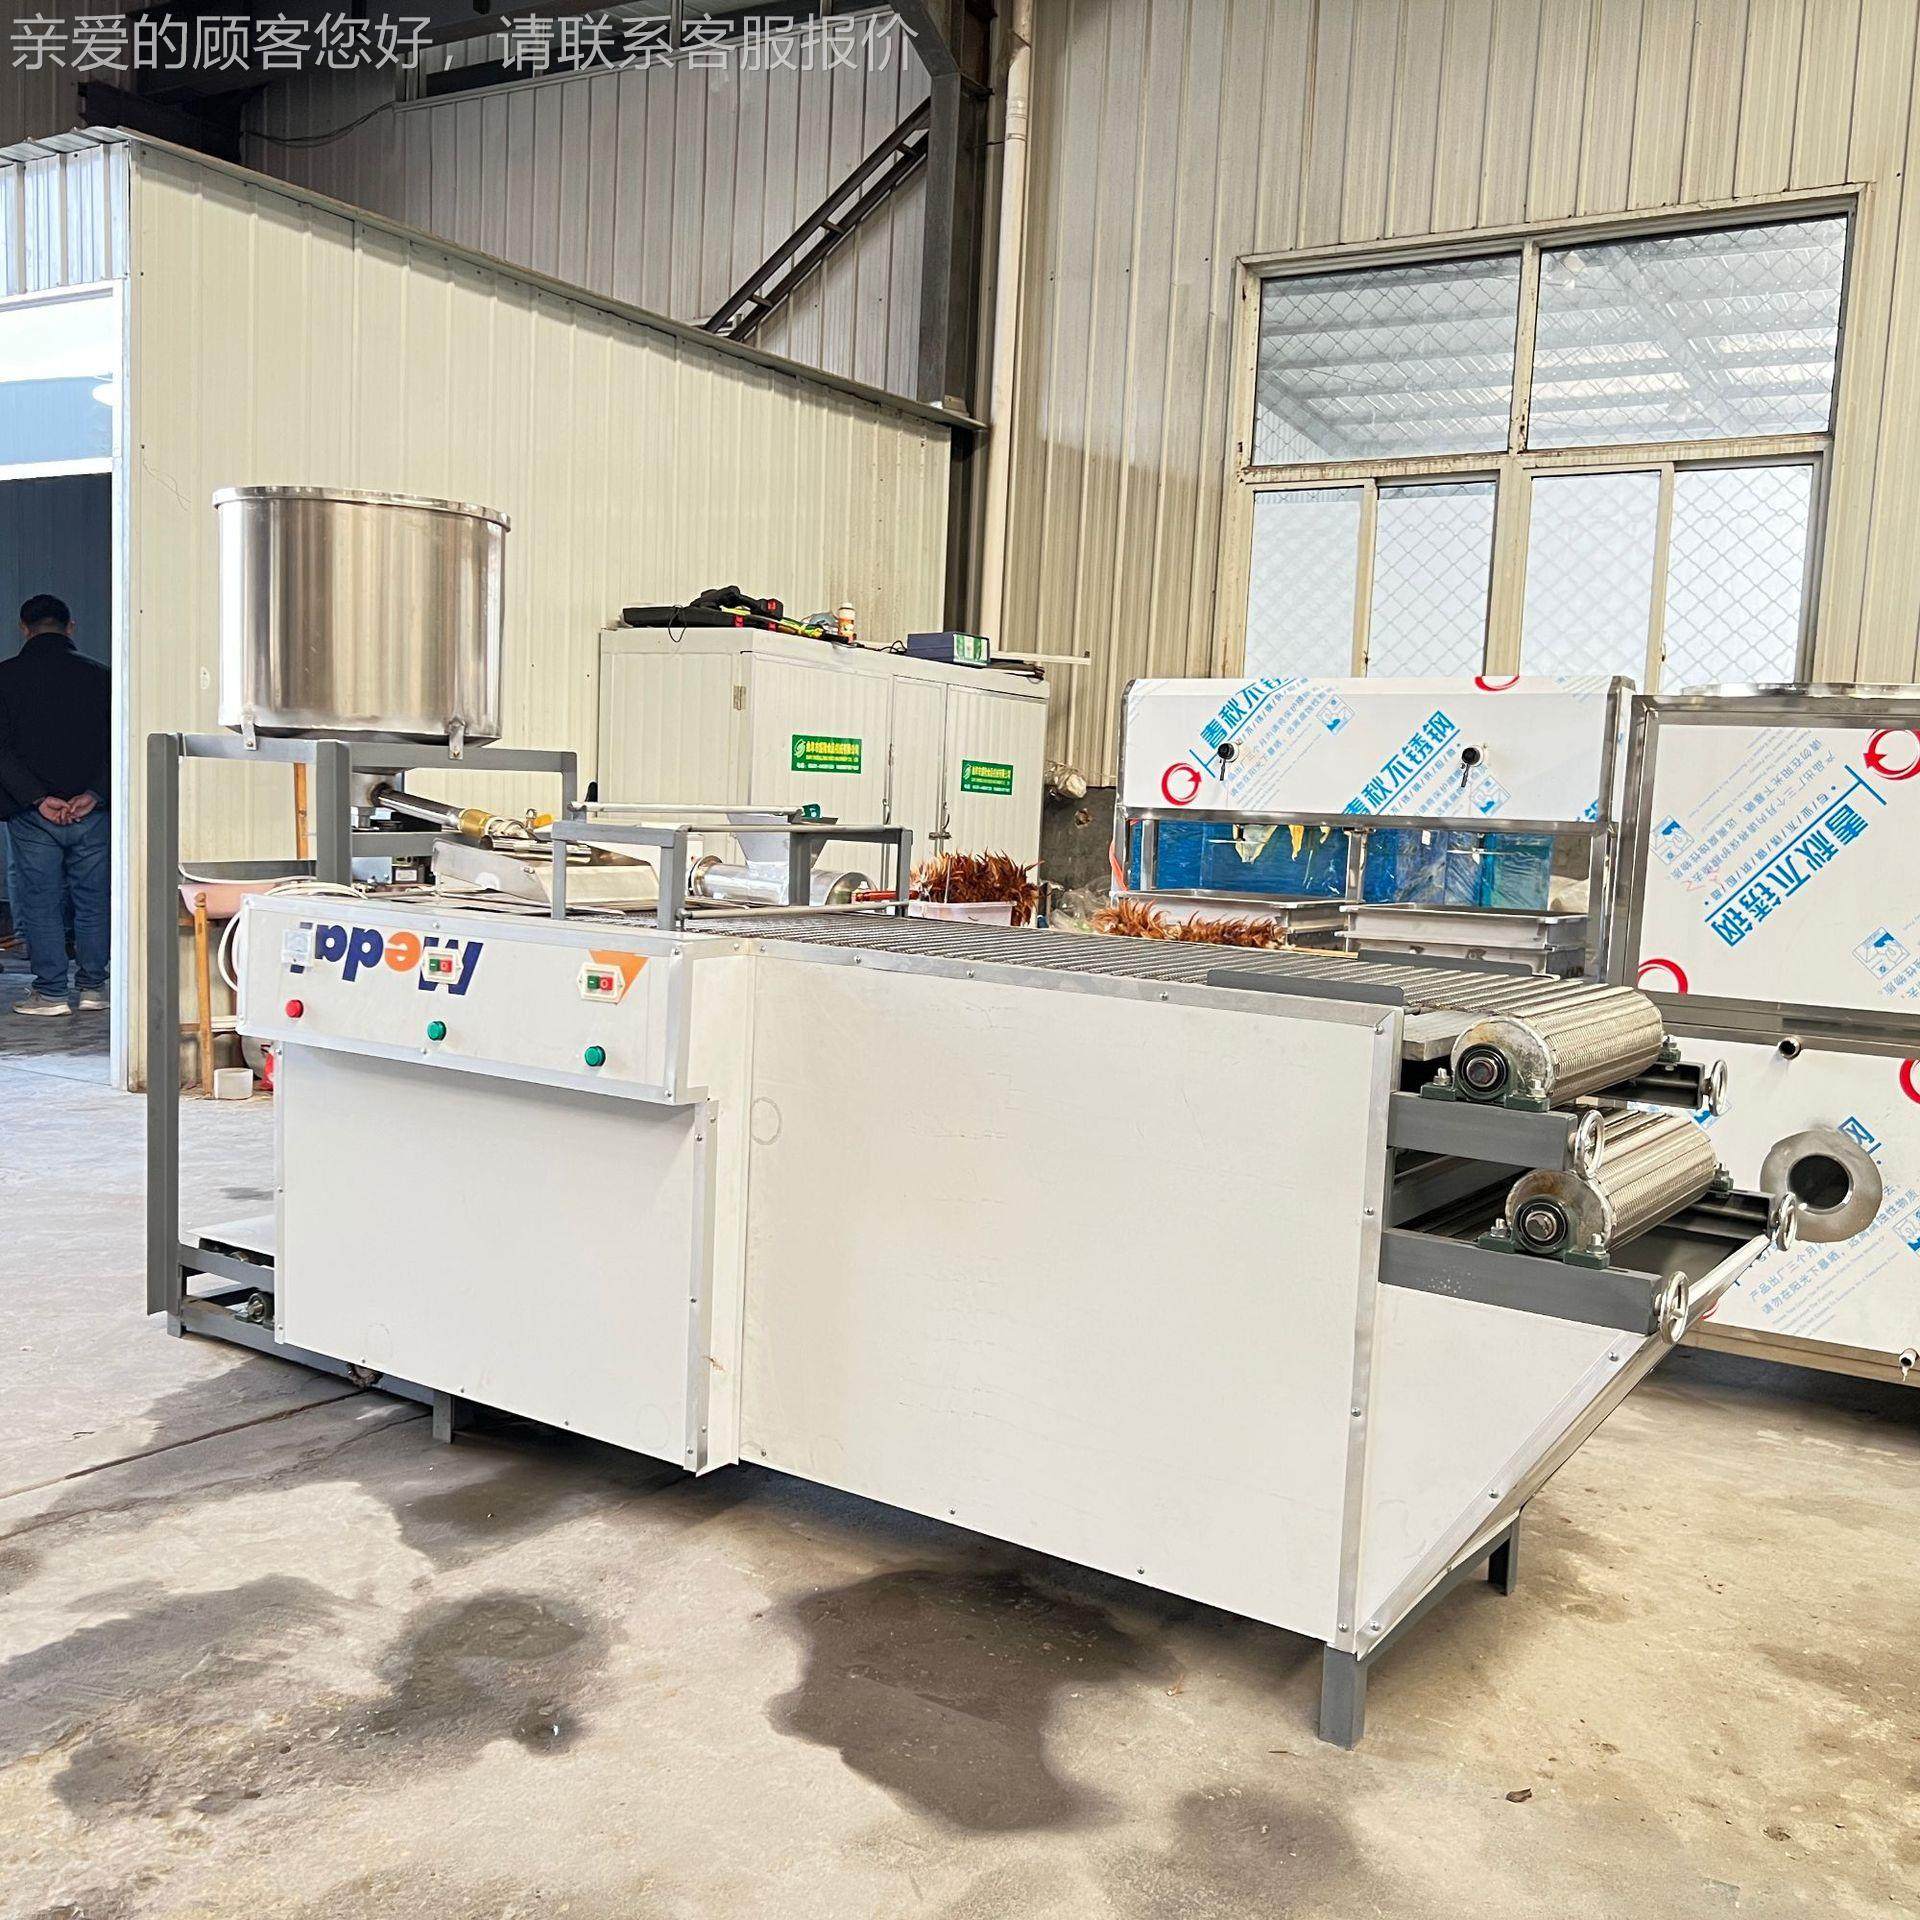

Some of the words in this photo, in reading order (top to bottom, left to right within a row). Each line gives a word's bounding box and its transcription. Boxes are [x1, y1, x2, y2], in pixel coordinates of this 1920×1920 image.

[1708, 803, 1868, 948] 春秋不锈钢
